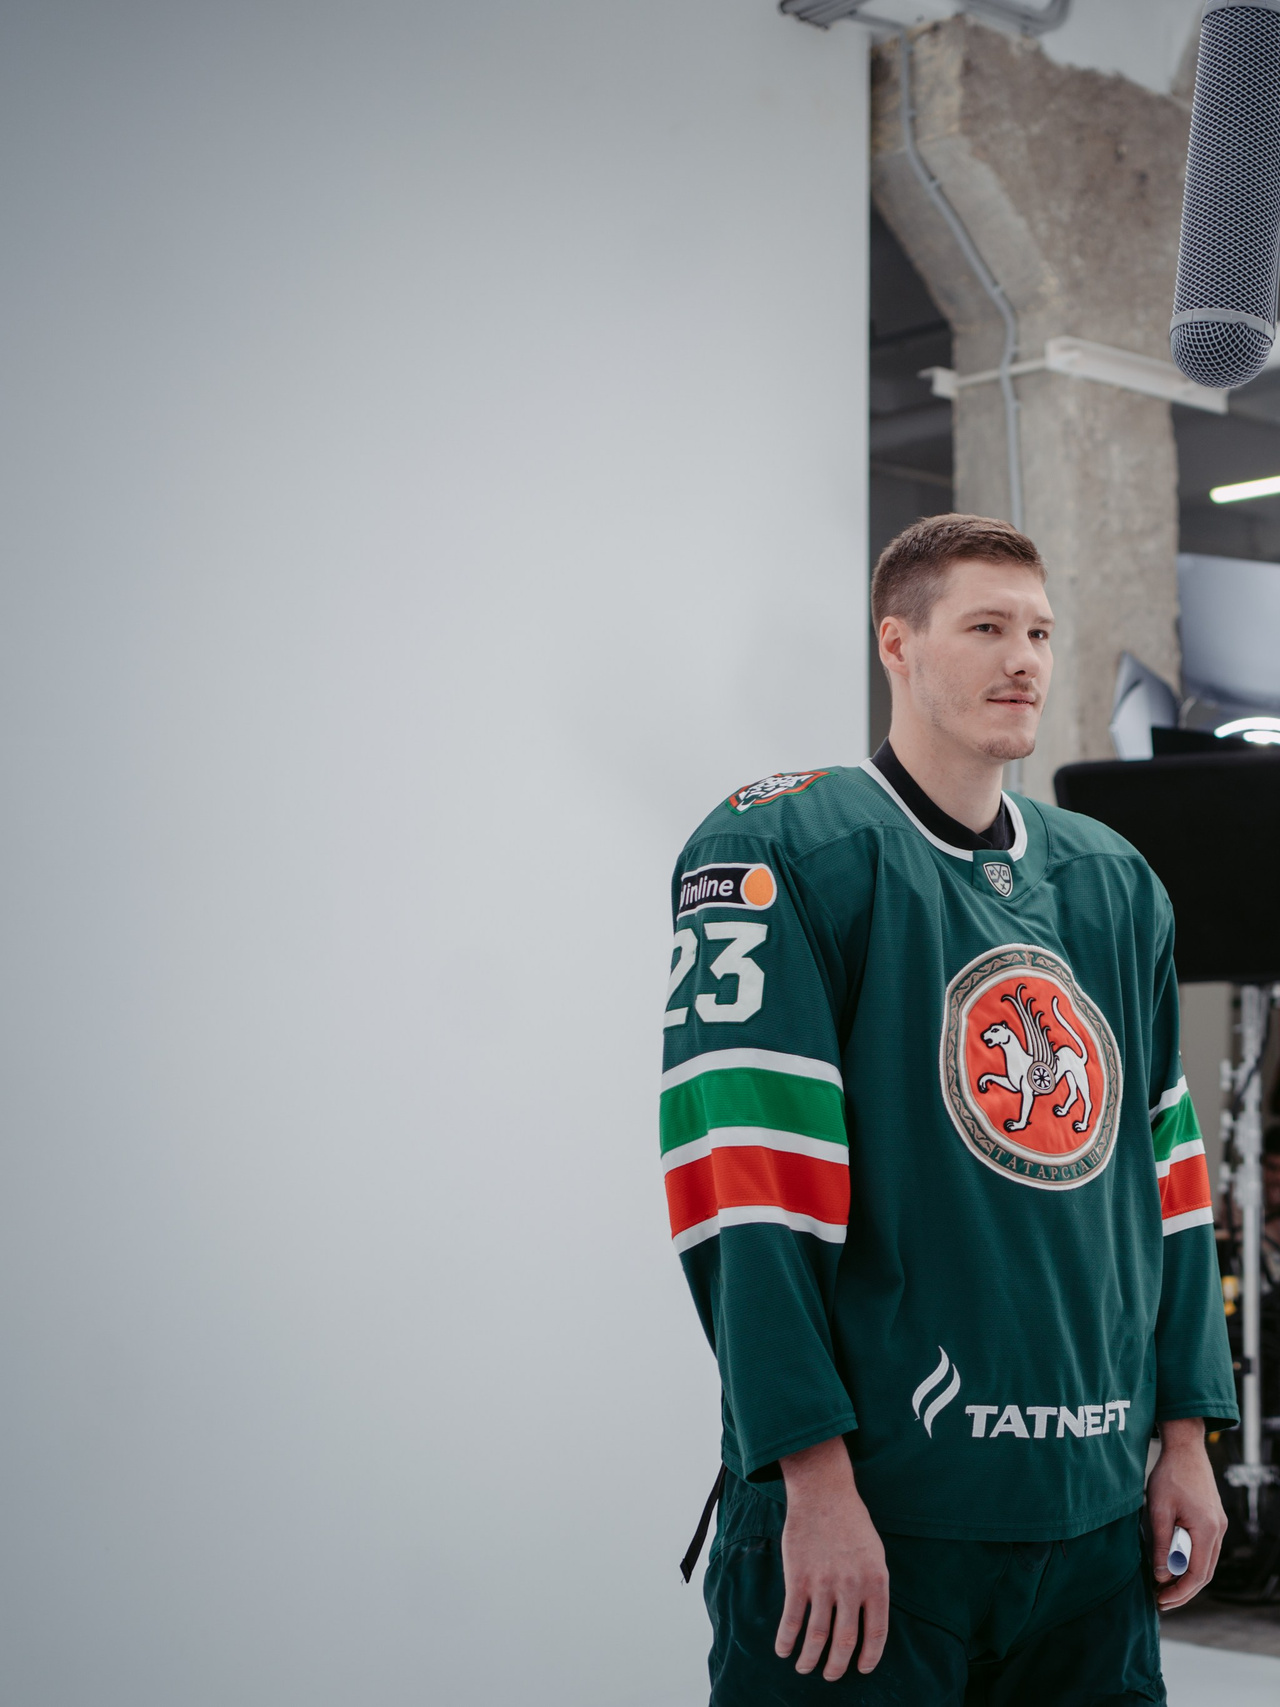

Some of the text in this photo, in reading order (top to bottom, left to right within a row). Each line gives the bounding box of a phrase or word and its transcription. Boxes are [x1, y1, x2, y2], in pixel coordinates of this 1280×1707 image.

[664, 921, 768, 1028] 23
[995, 1147, 1100, 1180] ТАТАРСТАН
[965, 1400, 1131, 1439] TATNEFT
